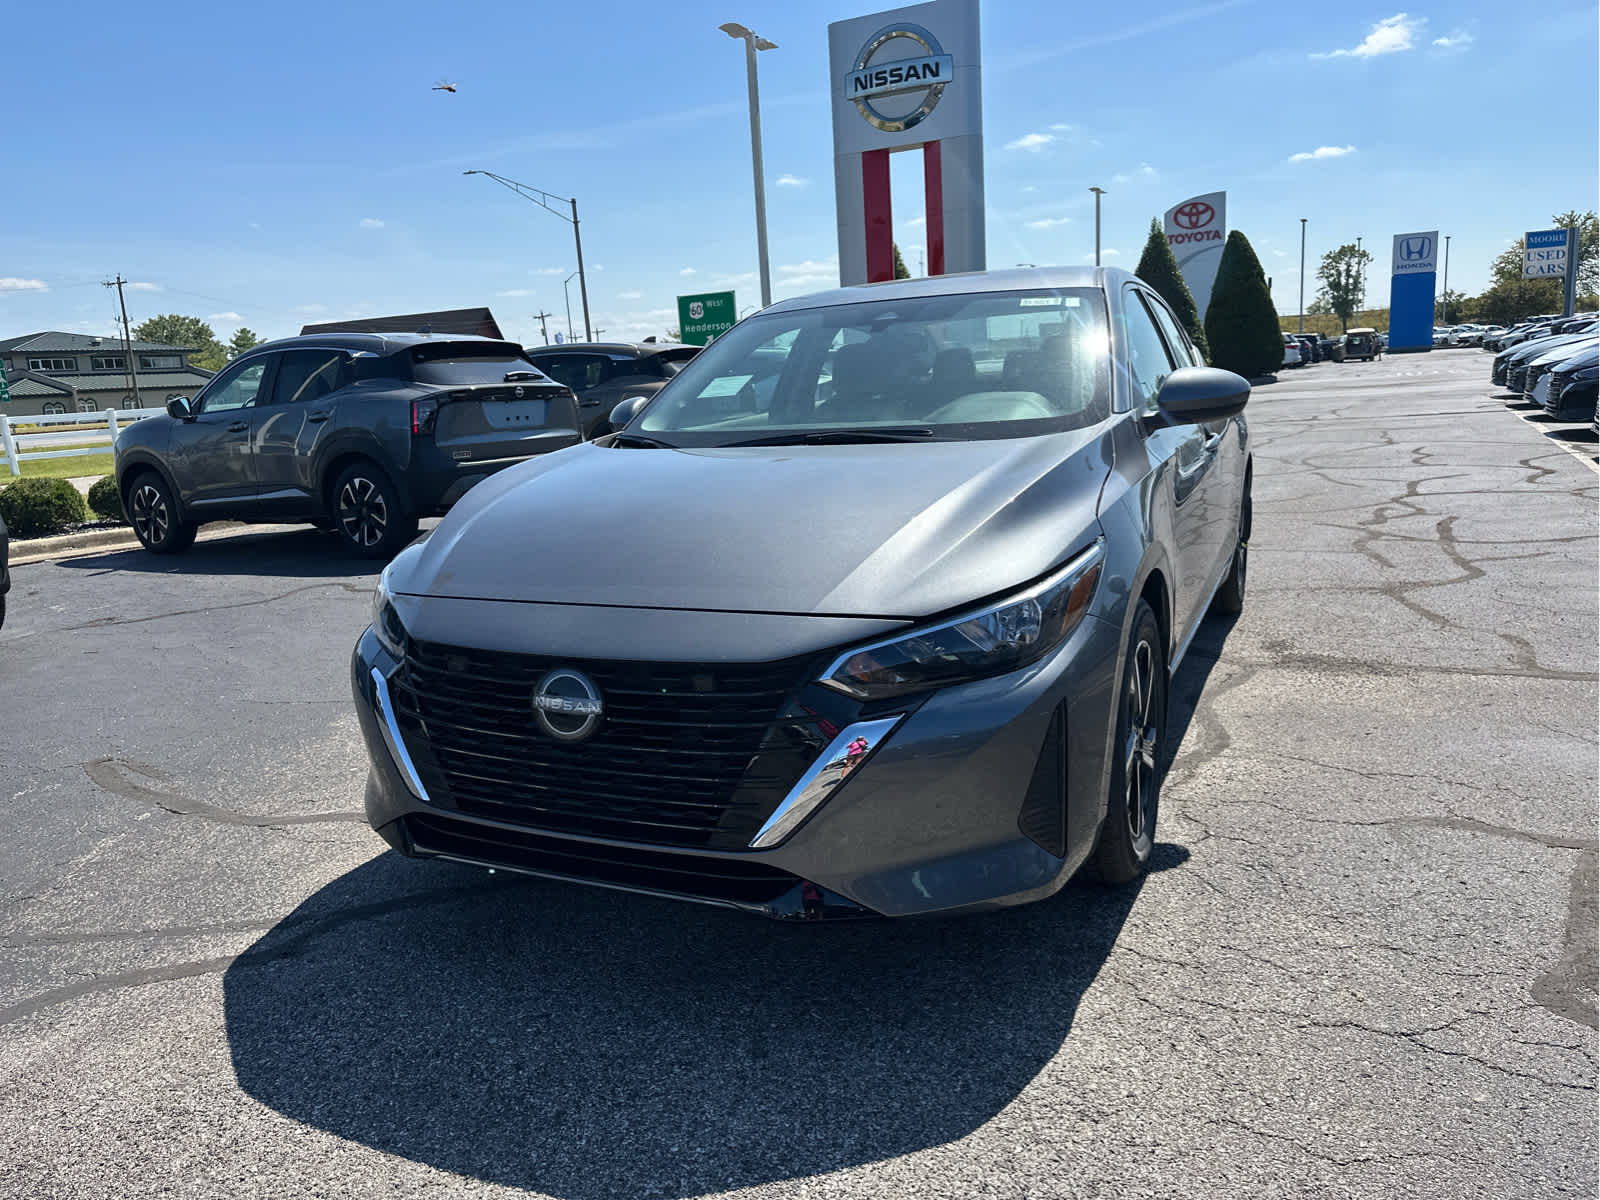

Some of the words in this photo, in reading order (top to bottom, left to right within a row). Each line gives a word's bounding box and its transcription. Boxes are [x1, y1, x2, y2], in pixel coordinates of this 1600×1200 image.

[854, 61, 940, 92] NISSAN
[1168, 230, 1222, 245] TOYOTA
[1529, 234, 1565, 244] MOORE
[1527, 249, 1566, 261] USED
[1525, 263, 1565, 275] CARS
[685, 322, 731, 333] Henderson
[535, 696, 601, 713] NISSAN
